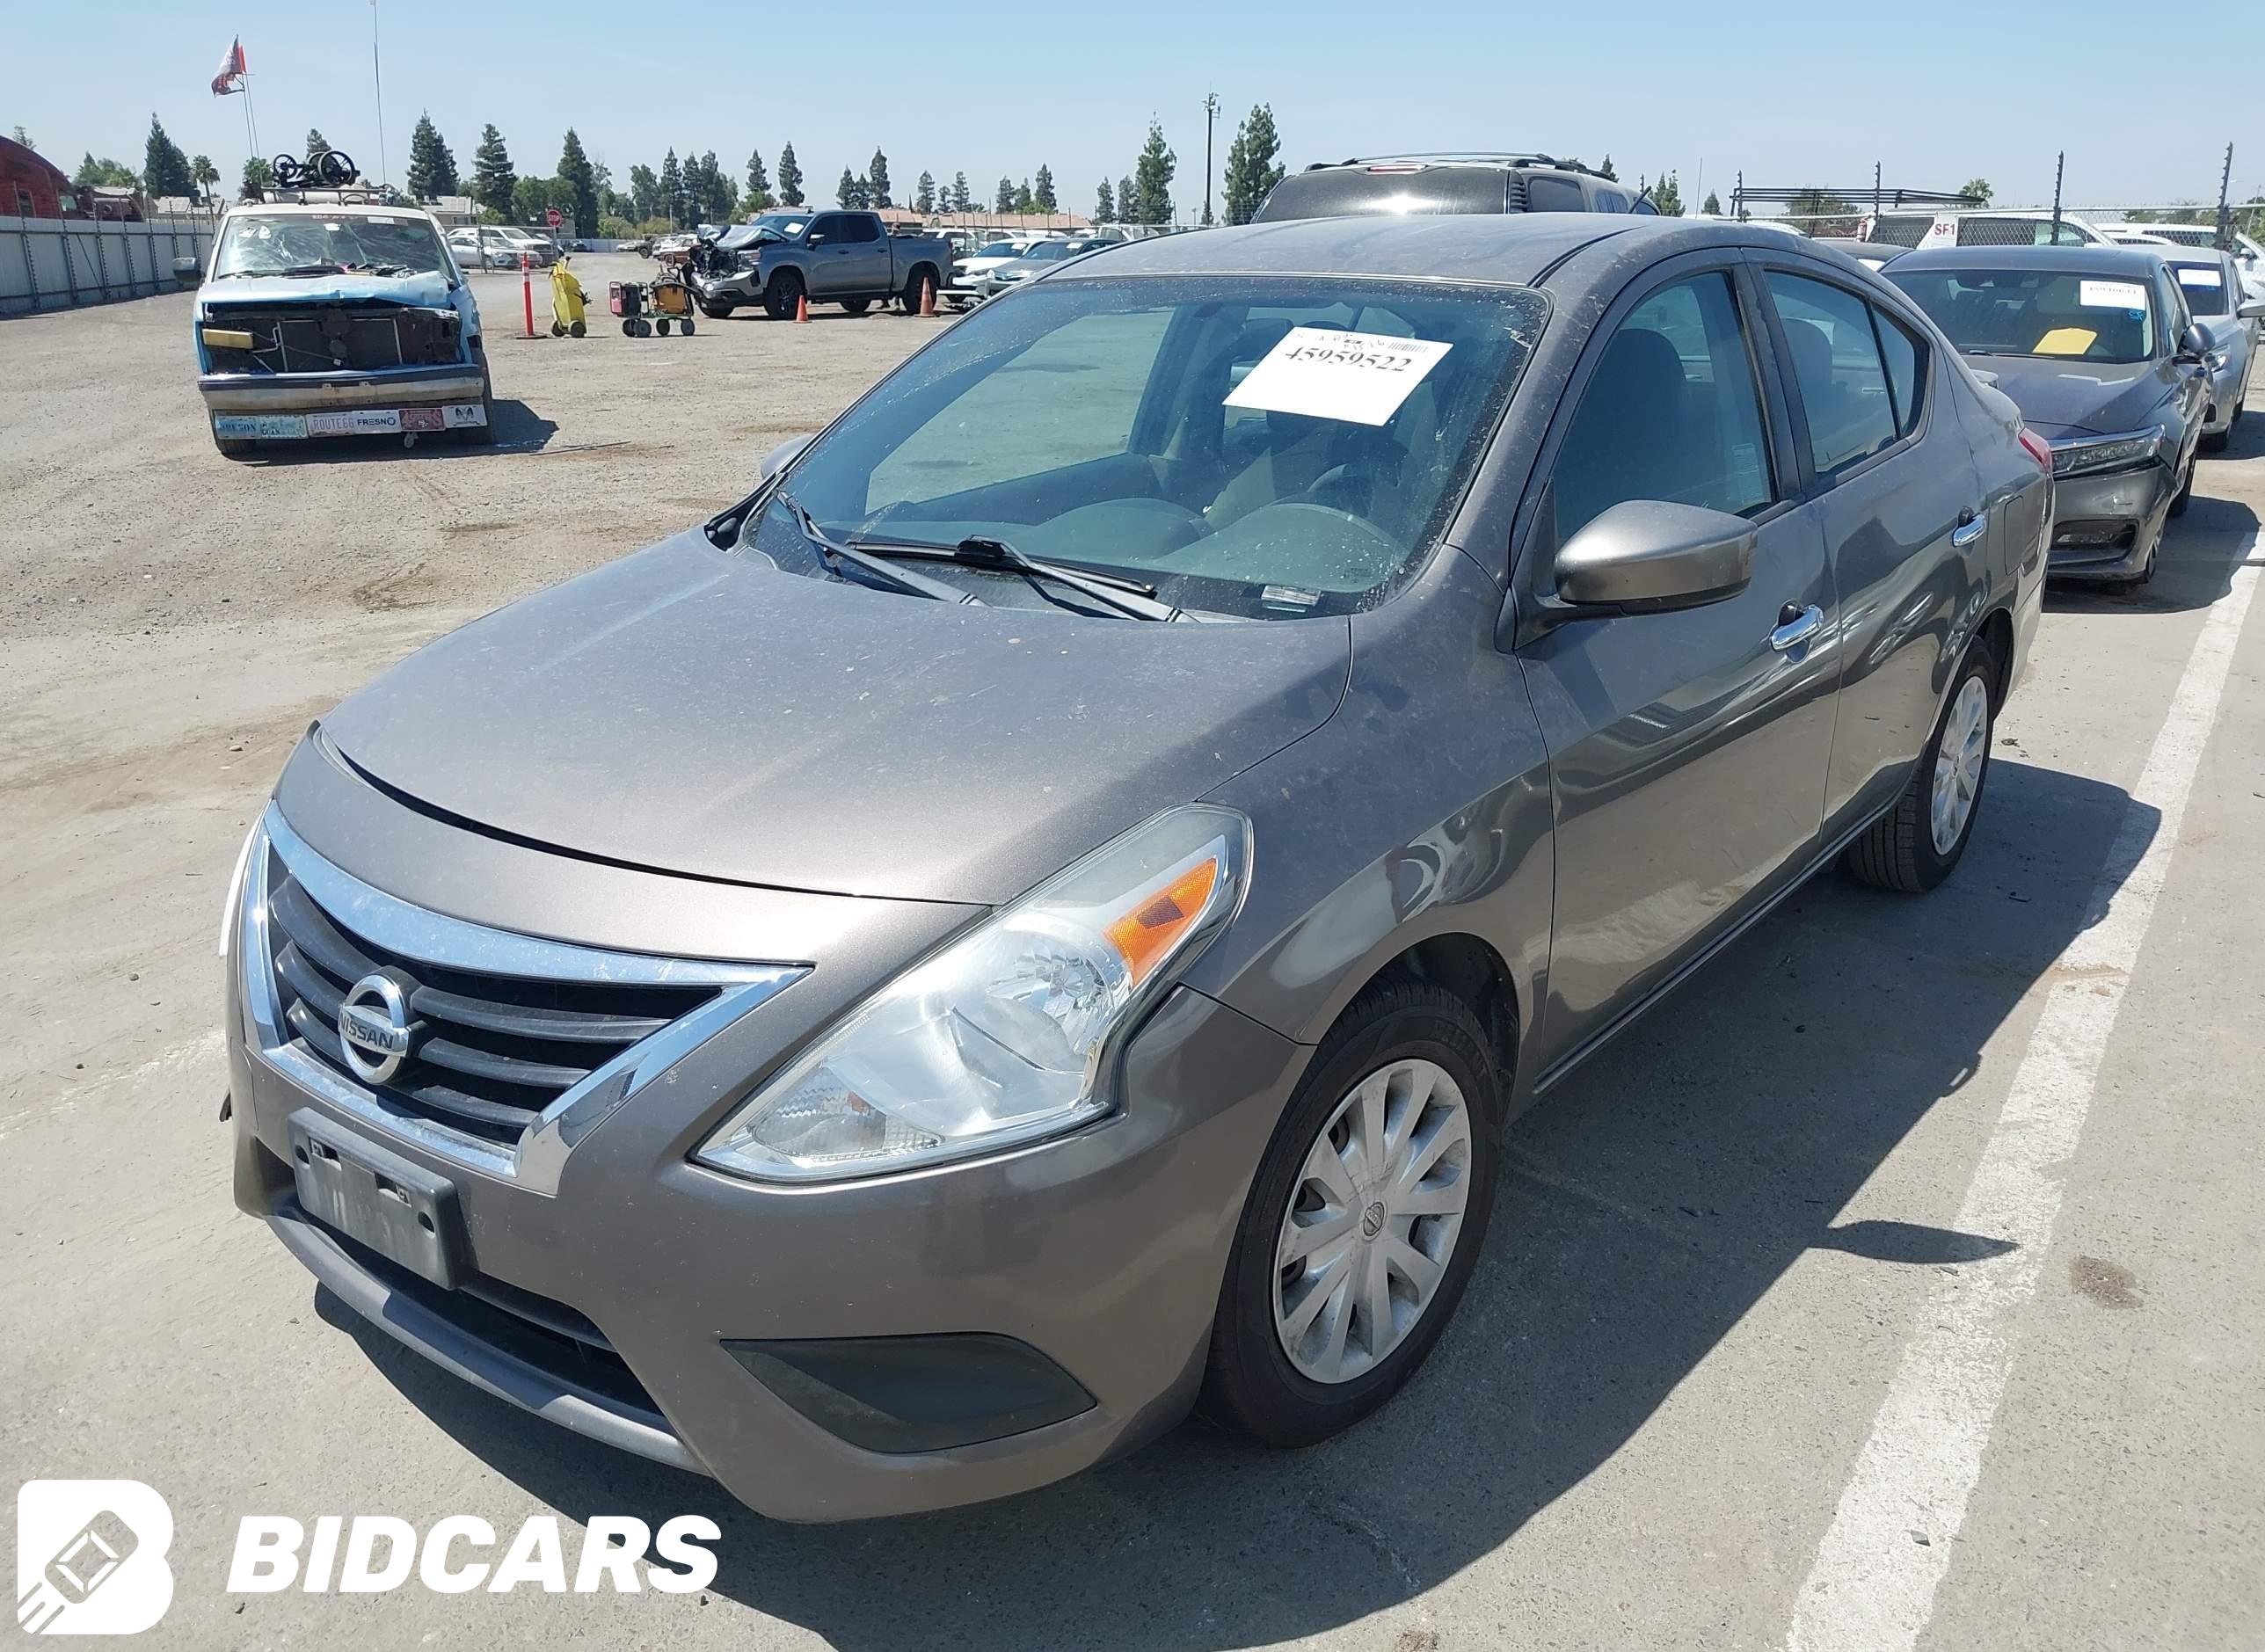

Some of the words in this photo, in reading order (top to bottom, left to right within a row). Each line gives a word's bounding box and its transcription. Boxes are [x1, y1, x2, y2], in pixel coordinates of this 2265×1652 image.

[1934, 223, 1955, 236] SF1
[1285, 346, 1411, 371] 45959522
[357, 417, 396, 426] FRESNO
[339, 1012, 393, 1049] NISSAN
